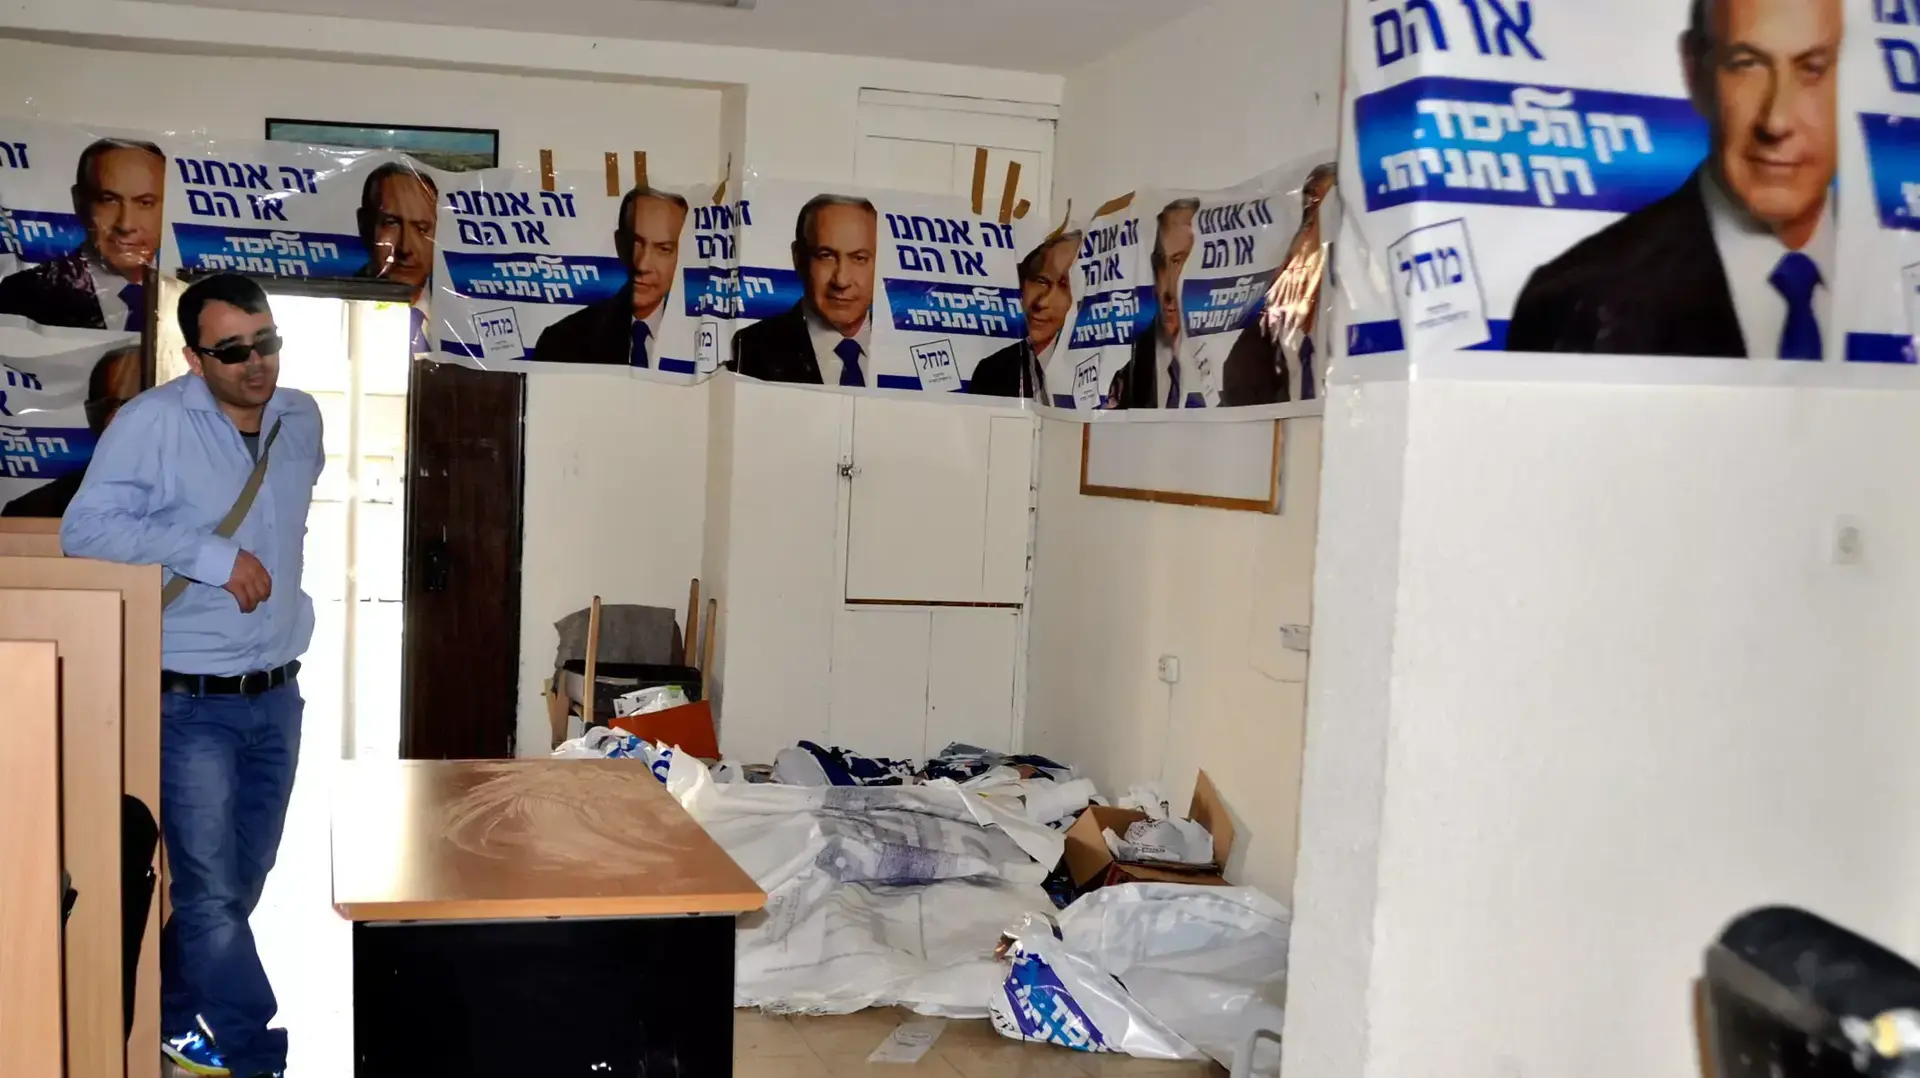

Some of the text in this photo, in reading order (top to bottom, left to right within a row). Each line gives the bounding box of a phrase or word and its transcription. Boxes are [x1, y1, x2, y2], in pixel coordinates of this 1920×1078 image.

[1372, 0, 1547, 67] או הם
[1875, 38, 1920, 94] ם
[1413, 86, 1654, 164] רק הליכוד.
[174, 158, 318, 194] זה אנחנו
[1378, 147, 1597, 208] רק נתניהו.
[186, 189, 289, 221] או הם
[446, 190, 577, 218] זה אנחנו
[21, 220, 55, 243] רק
[222, 231, 340, 263] רק הליכוד.
[456, 218, 551, 246] או הם
[885, 213, 1015, 250] זה אנחנו
[896, 244, 989, 277] או הם
[1201, 235, 1255, 270] או הם
[491, 255, 600, 286] רק הליכוד.
[1396, 246, 1463, 298] מחל
[466, 279, 575, 304] רק נתניהו.
[742, 275, 775, 299] רק
[928, 287, 1024, 319] ק הליכוד.
[477, 316, 515, 338] מחל
[904, 308, 1009, 336] רק נתניהו.
[915, 348, 950, 371] מחל
[35, 436, 70, 459] רק
[5, 455, 40, 477] רק
